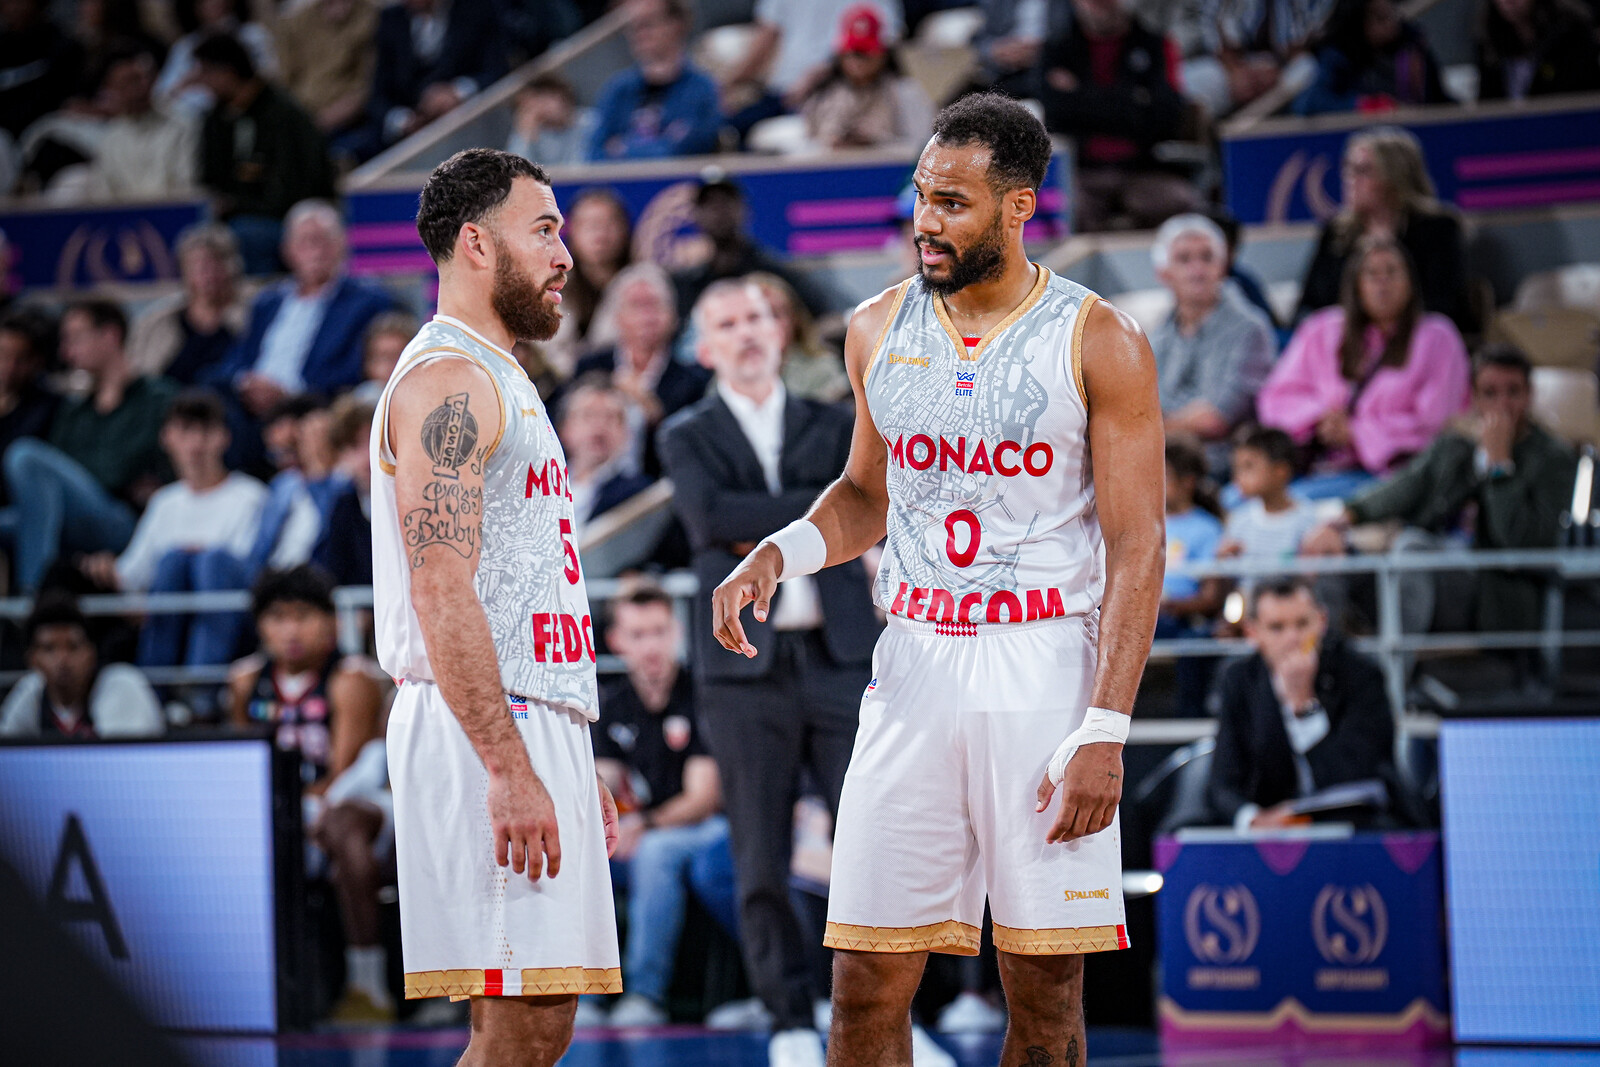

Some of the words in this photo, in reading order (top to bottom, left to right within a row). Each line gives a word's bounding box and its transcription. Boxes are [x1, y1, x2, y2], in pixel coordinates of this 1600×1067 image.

[888, 353, 930, 368] SPALDING
[956, 388, 973, 396] ELITE
[882, 433, 1054, 477] MONACO
[559, 518, 580, 585] 5
[945, 509, 981, 567] 0
[1064, 888, 1109, 901] SPALDING
